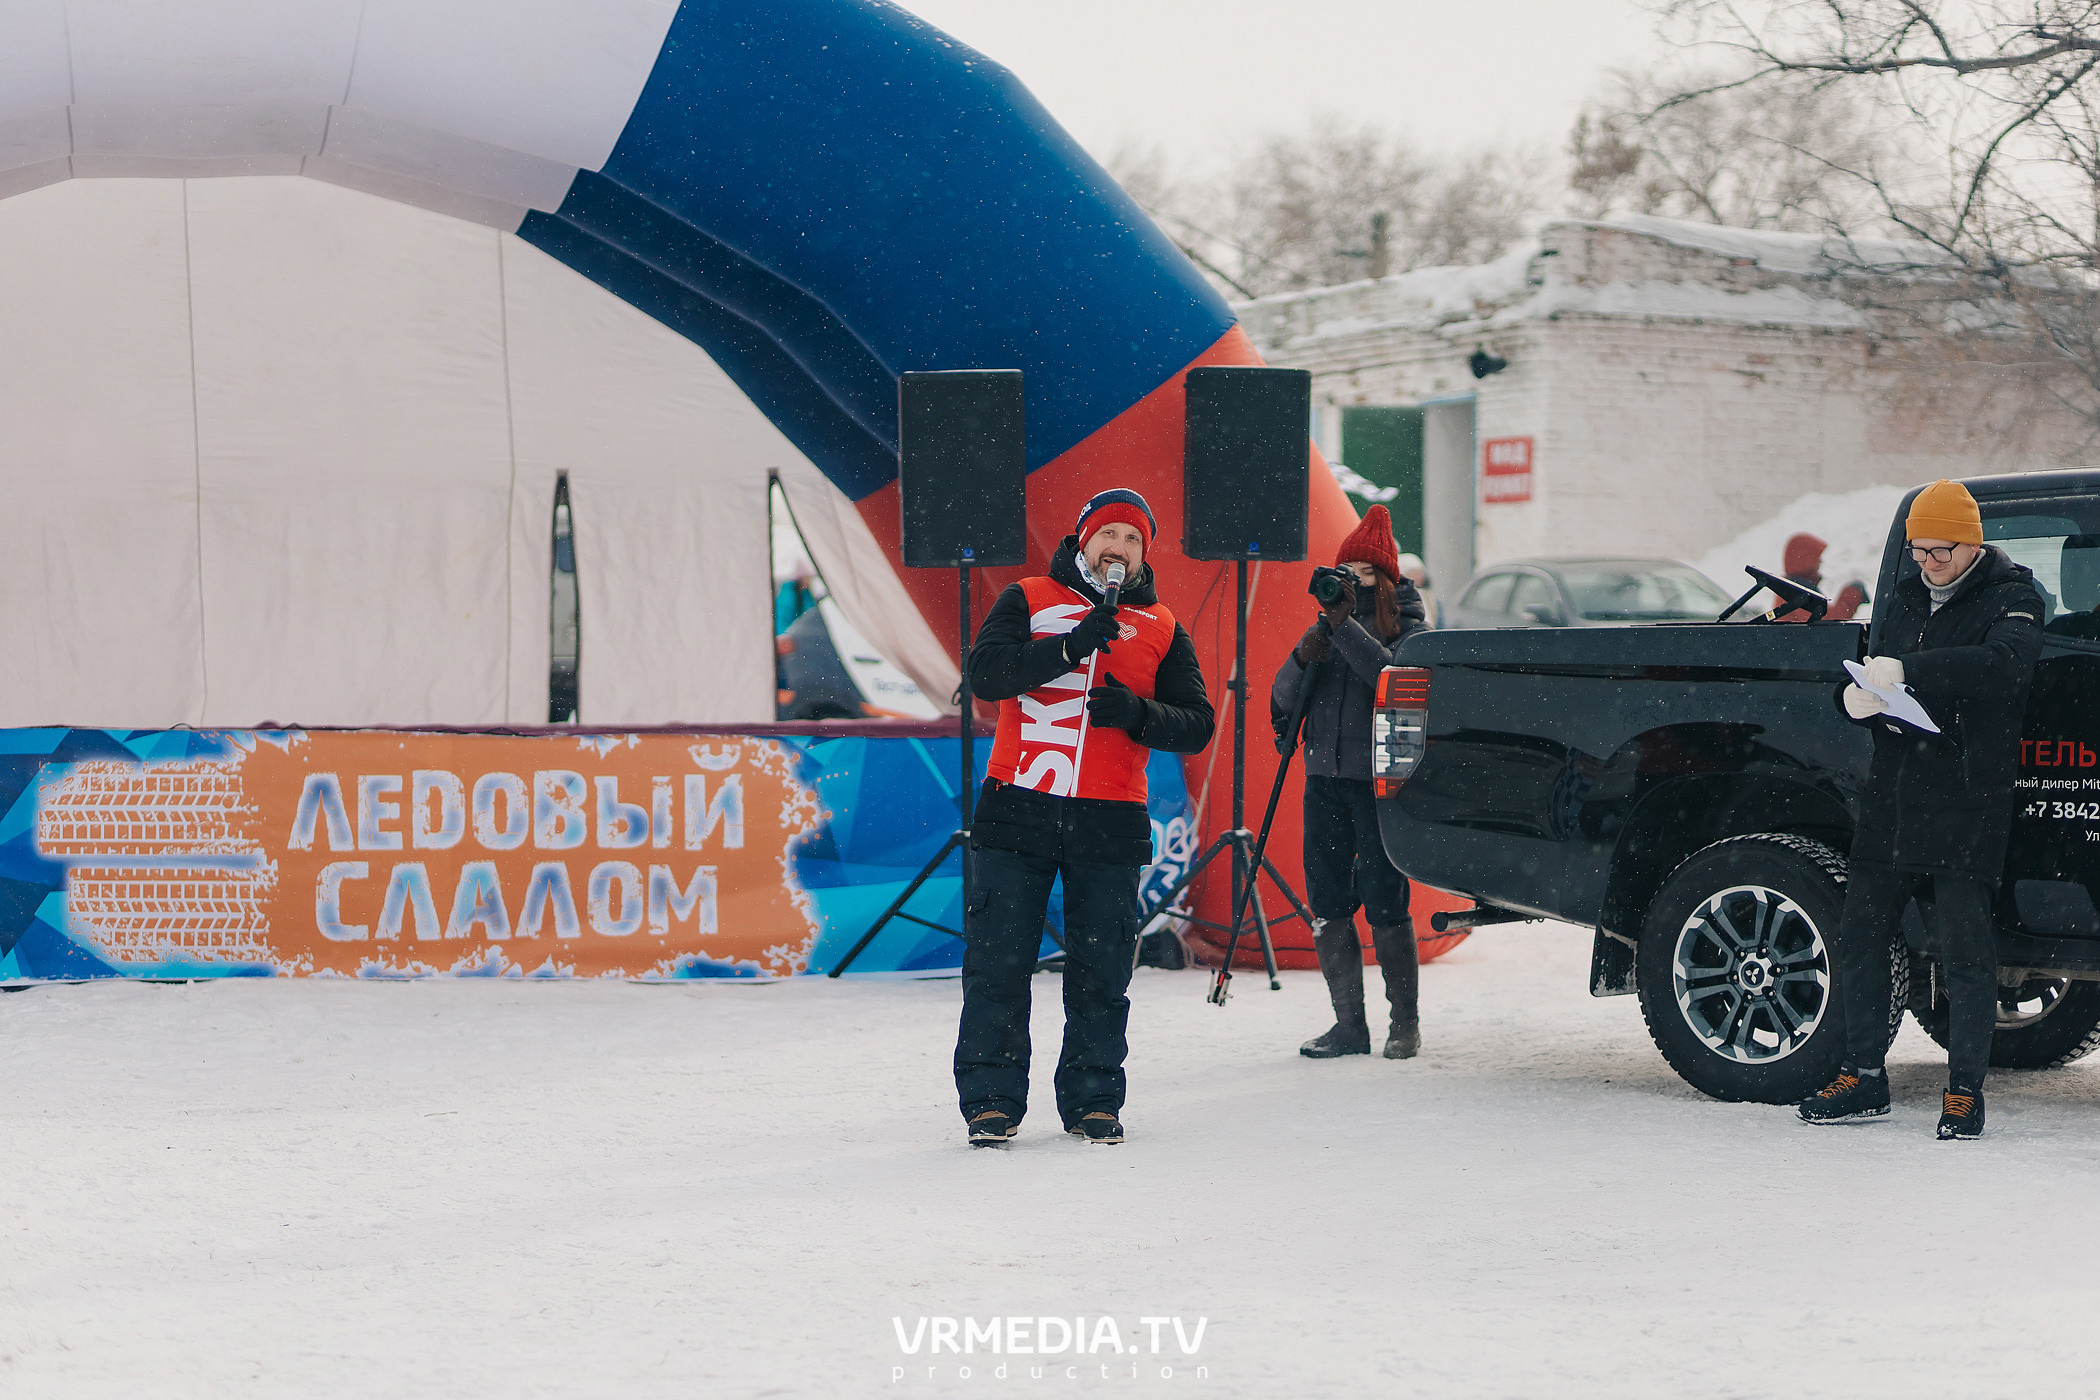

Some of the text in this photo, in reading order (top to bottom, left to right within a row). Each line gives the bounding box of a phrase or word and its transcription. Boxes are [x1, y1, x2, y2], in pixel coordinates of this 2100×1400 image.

[287, 743, 744, 851] ЛЕДОВЫЙ
[2041, 778, 2079, 792] дилер
[2025, 801, 2100, 820] +7 3842
[314, 859, 720, 941] СЛАЛОМ
